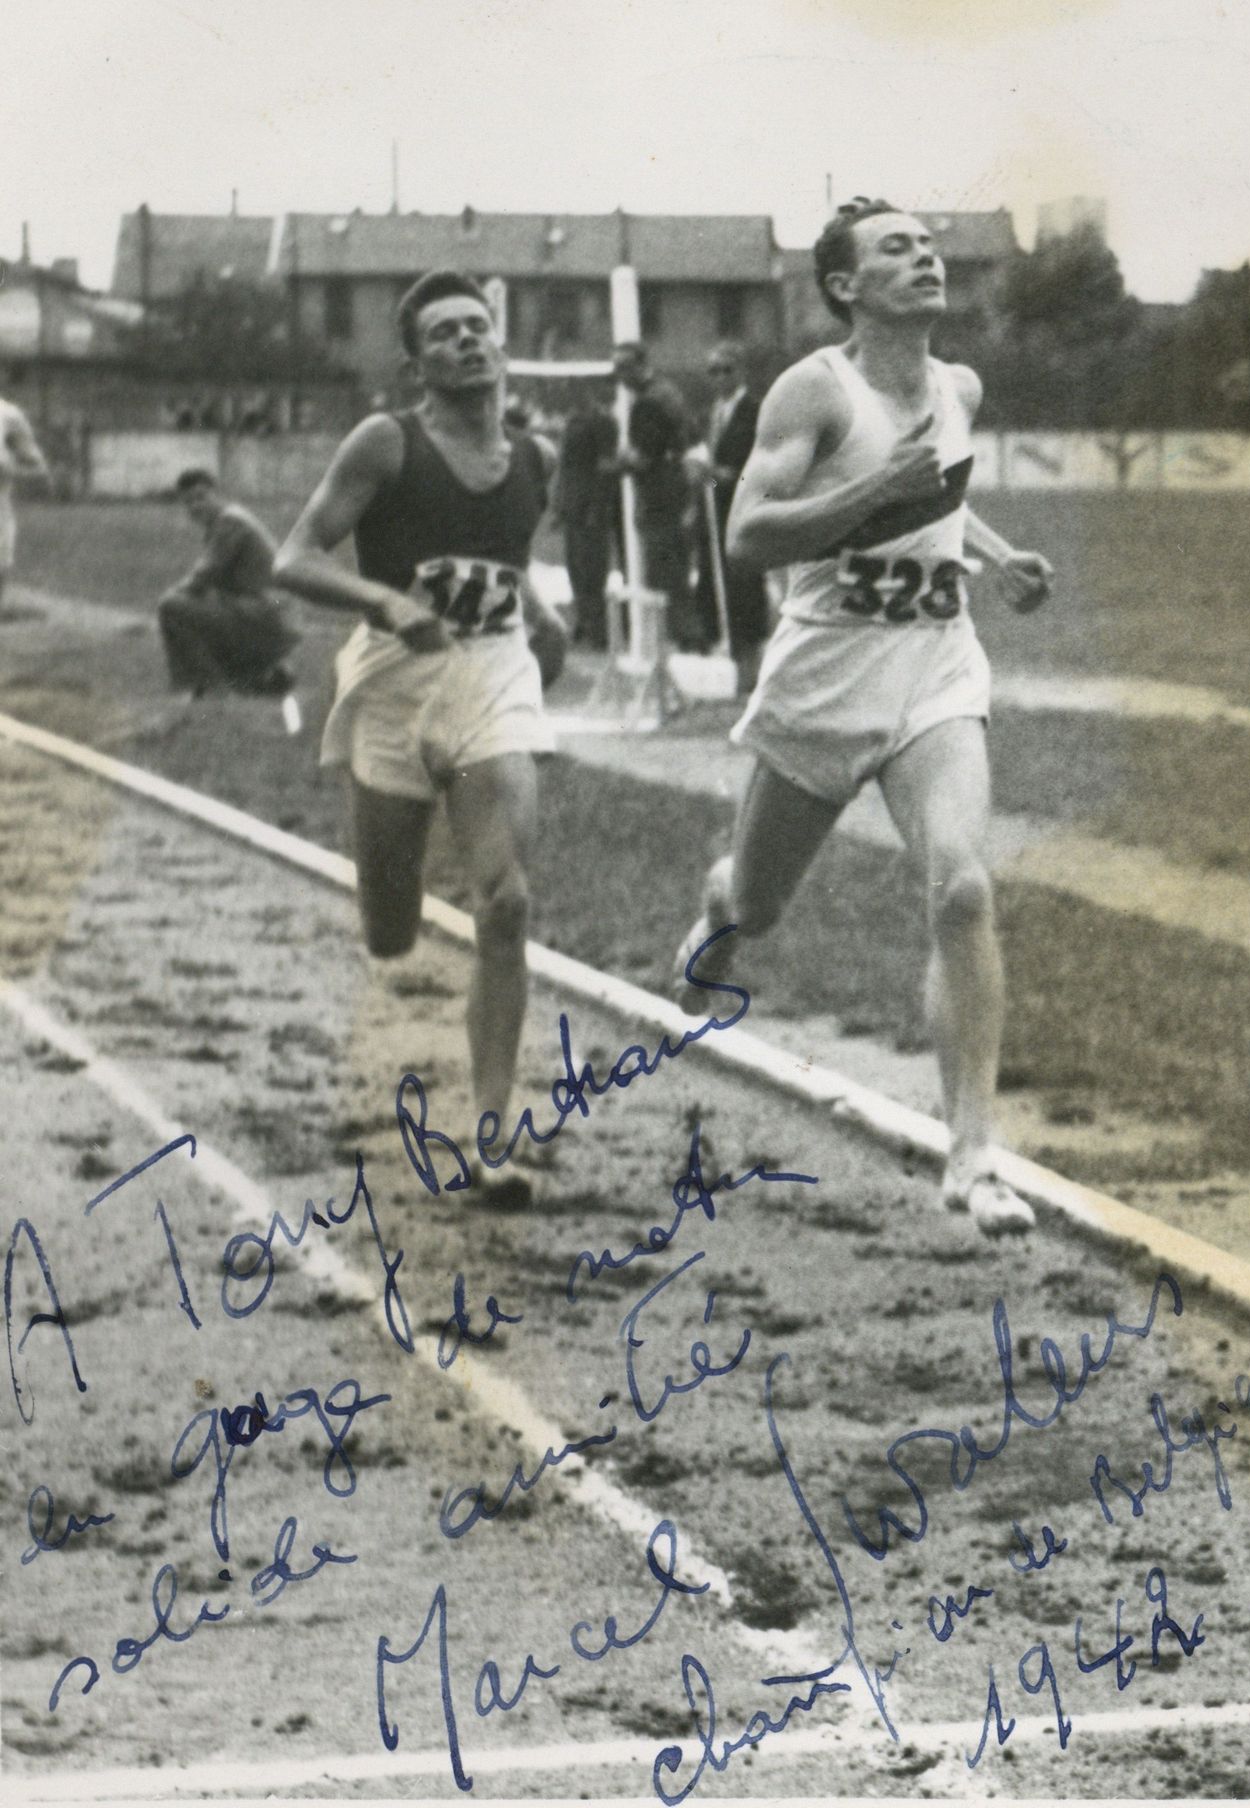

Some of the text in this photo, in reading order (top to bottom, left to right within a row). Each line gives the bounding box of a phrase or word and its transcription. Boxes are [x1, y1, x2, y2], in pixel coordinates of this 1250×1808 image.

[839, 553, 970, 624] 328
[3, 1219, 87, 1424] A
[85, 1135, 414, 1352] Tony
[438, 1272, 523, 1369] de
[377, 1521, 708, 1790] Marcel
